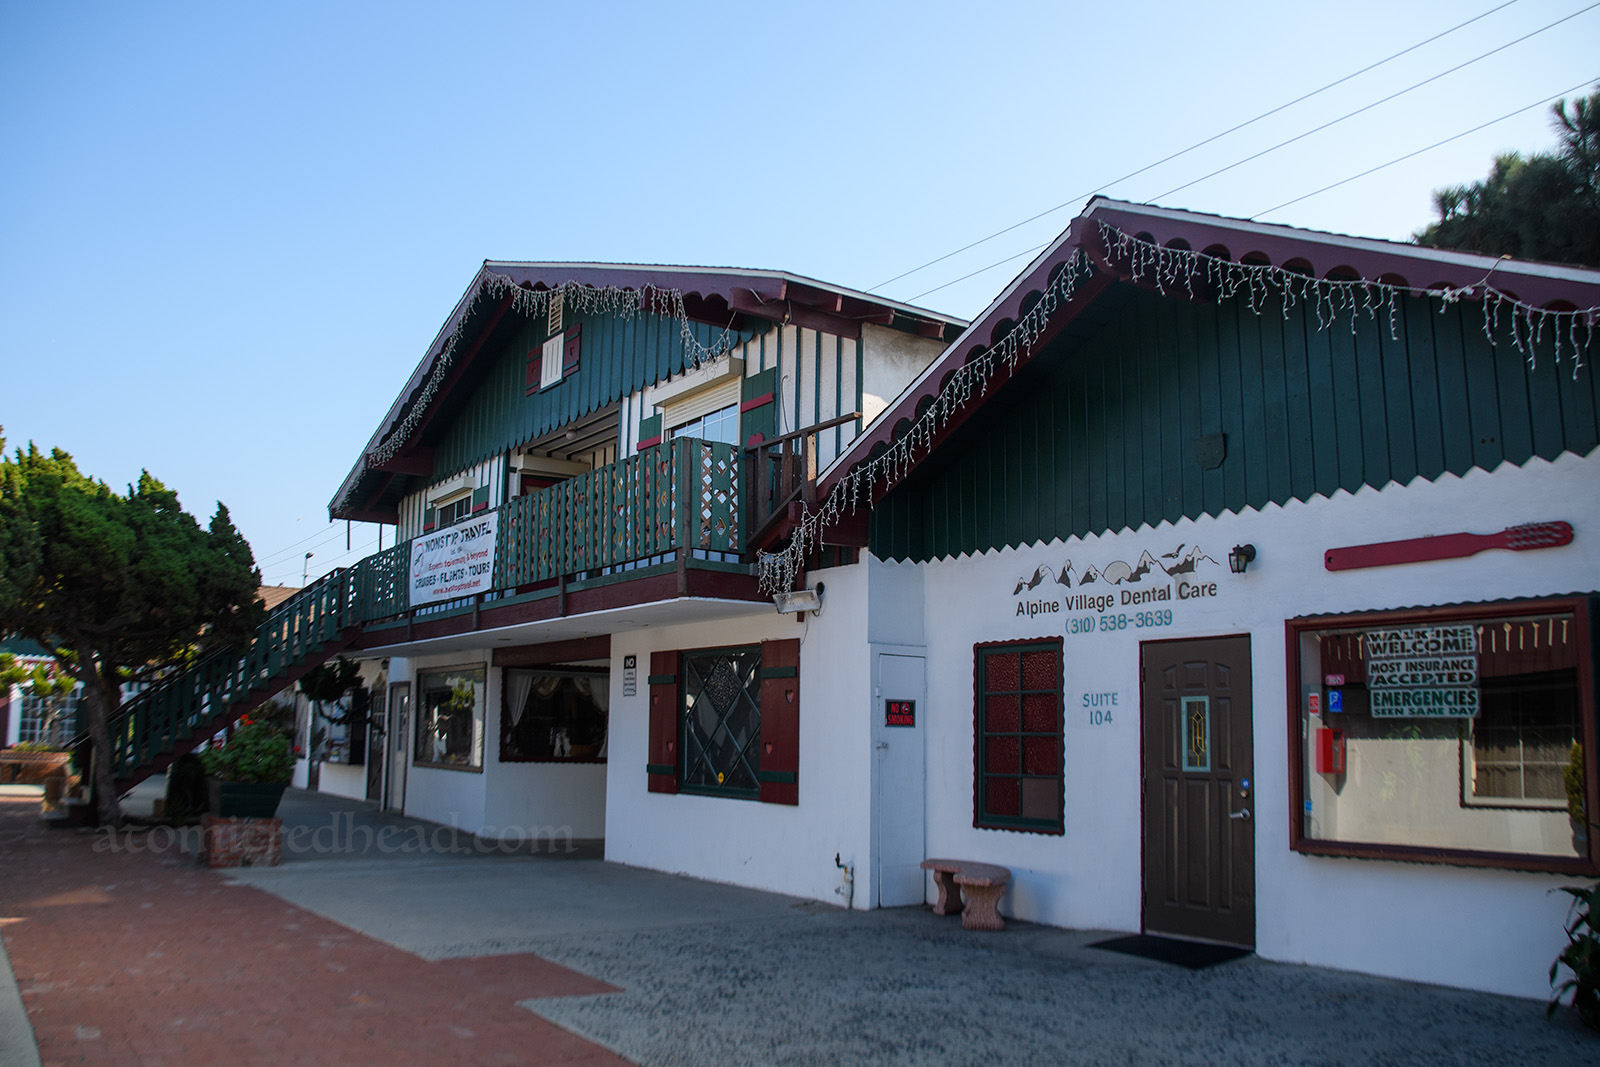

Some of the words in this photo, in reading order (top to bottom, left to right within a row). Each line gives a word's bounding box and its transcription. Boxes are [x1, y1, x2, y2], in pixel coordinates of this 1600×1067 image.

[460, 521, 492, 543] TRAVEL
[415, 575, 437, 589] CRUISES
[468, 561, 491, 577] TOURS
[1016, 601, 1060, 619] Alpine
[1065, 595, 1115, 612] Village
[1120, 584, 1171, 606] Dental
[1178, 581, 1218, 600] Care
[1065, 615, 1096, 634] (310)
[1099, 609, 1173, 632] 538-3639
[1369, 638, 1473, 655] WELCOME
[625, 657, 635, 668] NO
[1370, 662, 1402, 674] MOST
[1405, 659, 1474, 672] INSURANCE
[1373, 672, 1474, 686] ACCEPTED
[1082, 692, 1119, 708] SUITE
[1373, 690, 1477, 707] EMERGENCIES
[890, 703, 900, 714] NO
[1374, 707, 1405, 716] SEEN
[1408, 706, 1444, 716] SAME
[1449, 706, 1477, 715] DAY
[887, 714, 914, 726] SMOKING
[1090, 710, 1113, 726] 104
